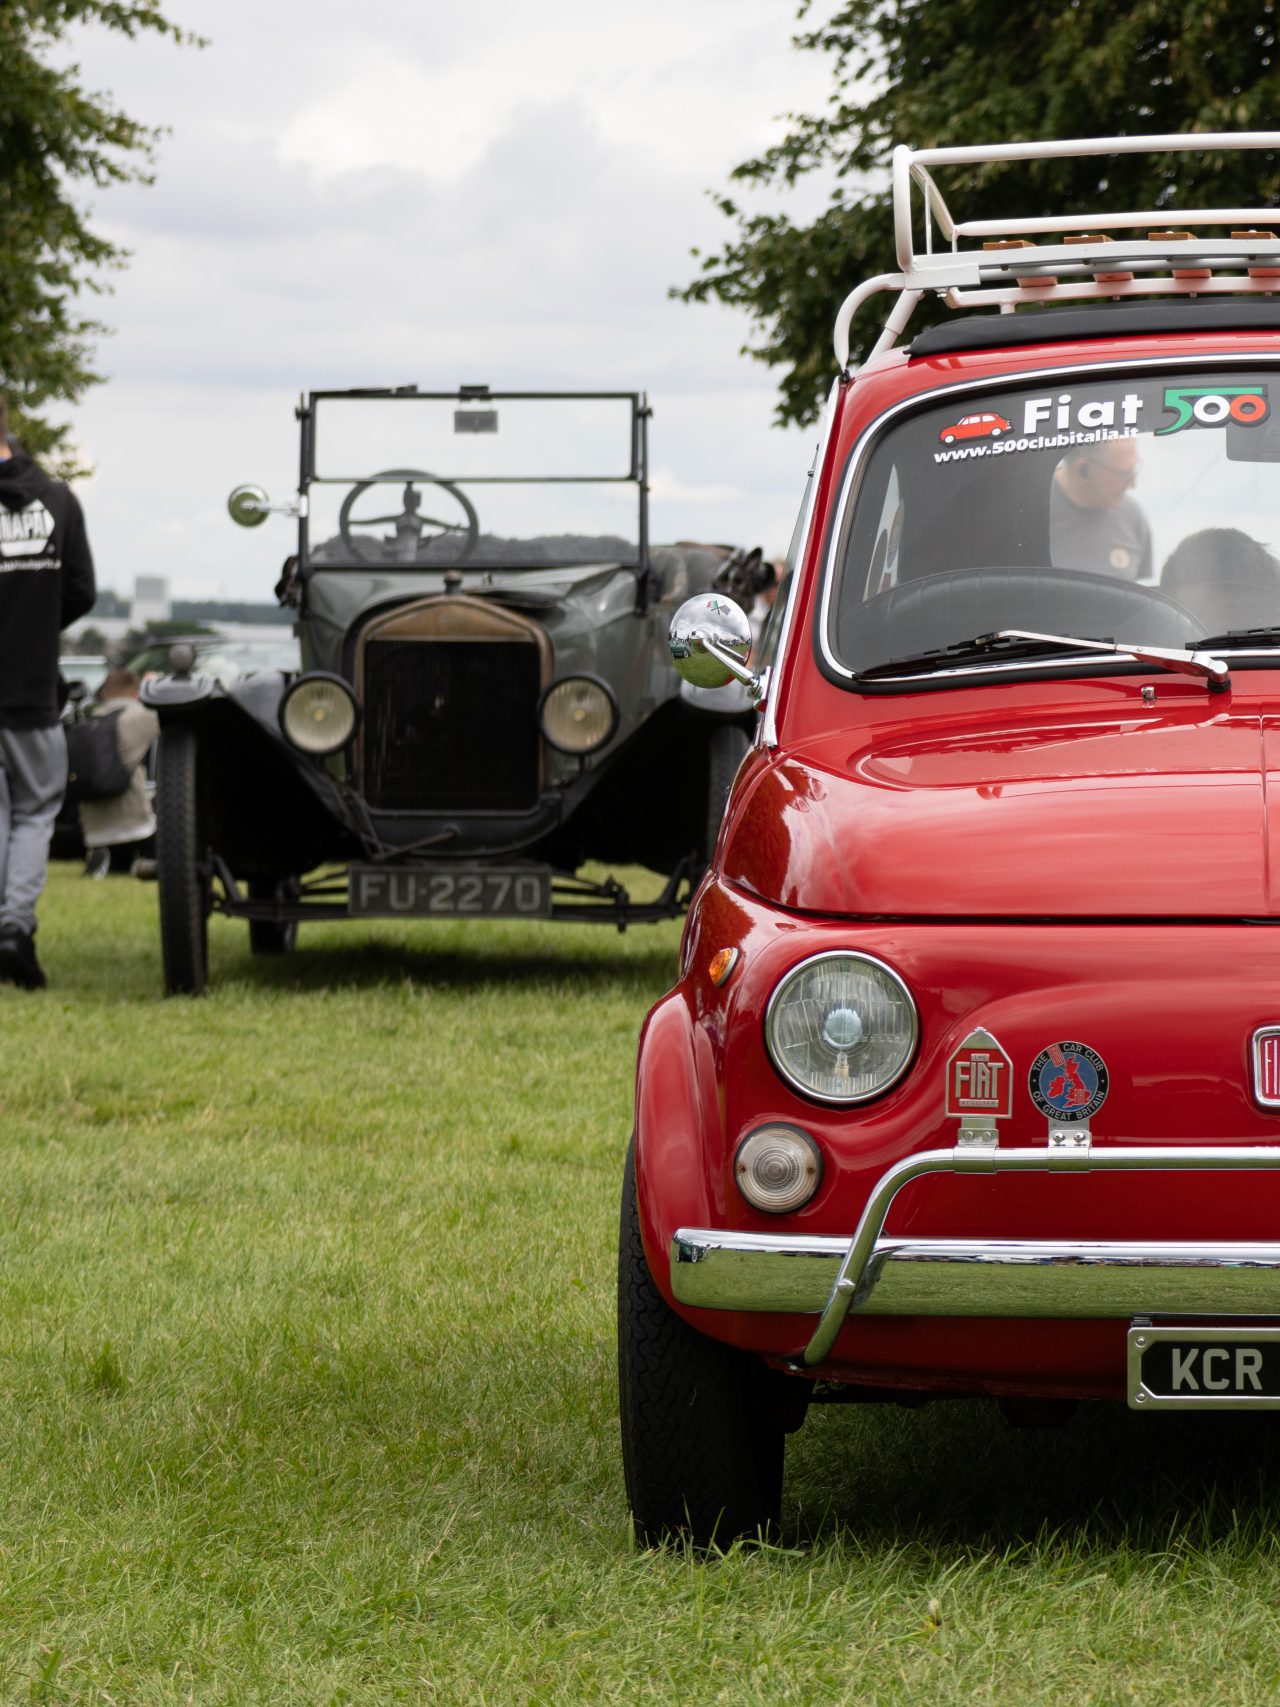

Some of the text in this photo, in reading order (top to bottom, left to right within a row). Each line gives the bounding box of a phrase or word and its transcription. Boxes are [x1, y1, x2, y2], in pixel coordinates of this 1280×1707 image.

[1023, 394, 1143, 435] Fiat
[1154, 384, 1268, 437] 500
[934, 426, 1139, 464] www.500clubitalia.it
[1033, 1053, 1049, 1071] THE
[1063, 1043, 1082, 1053] CAR
[1084, 1050, 1104, 1071] CLUB
[955, 1061, 1004, 1098] FIAT
[1033, 1091, 1044, 1103] OF
[1043, 1104, 1072, 1120] GREAT
[1075, 1090, 1105, 1119] BRITAIN
[1171, 1348, 1263, 1390] KCR
